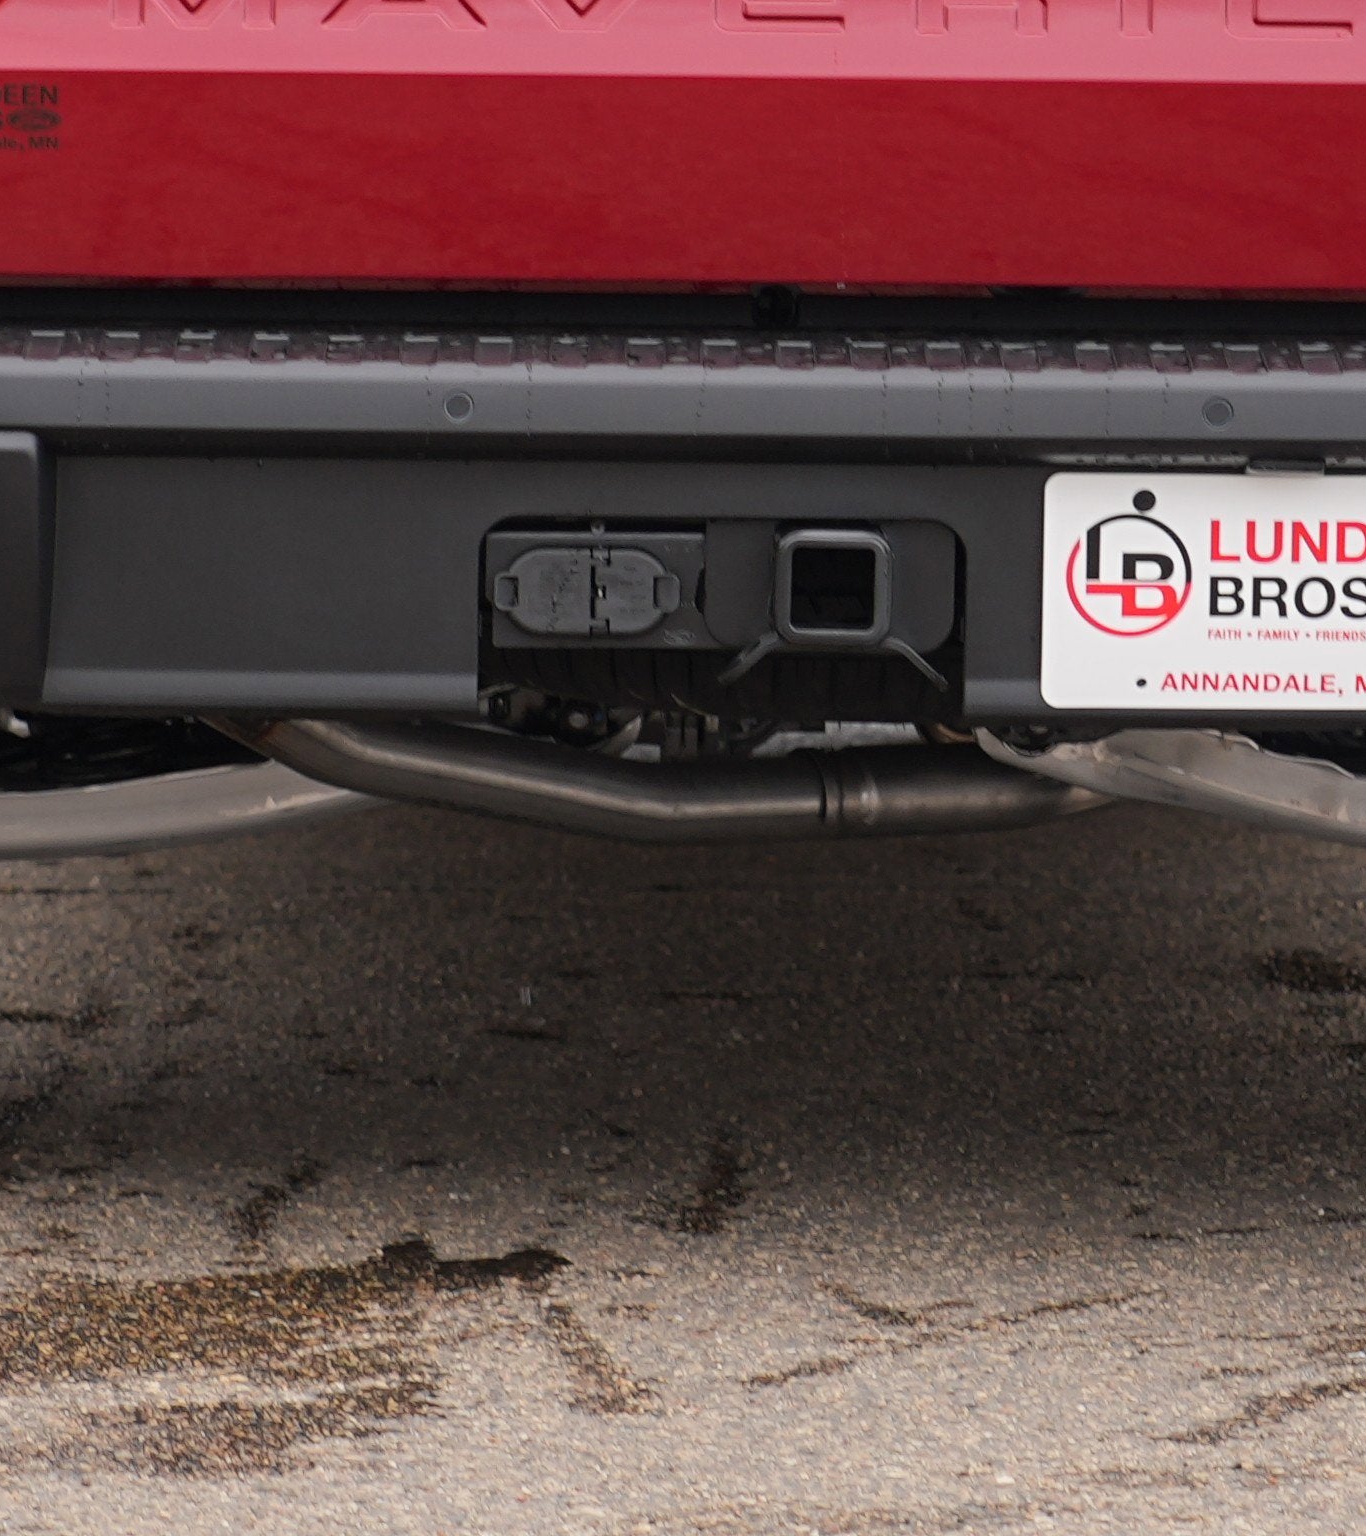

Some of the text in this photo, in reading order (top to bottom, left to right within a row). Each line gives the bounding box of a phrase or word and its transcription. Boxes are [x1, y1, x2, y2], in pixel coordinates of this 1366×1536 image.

[1206, 629, 1243, 641] FAITH
[1257, 629, 1300, 641] FAMILY
[1160, 671, 1344, 697] ANNANDALE,
